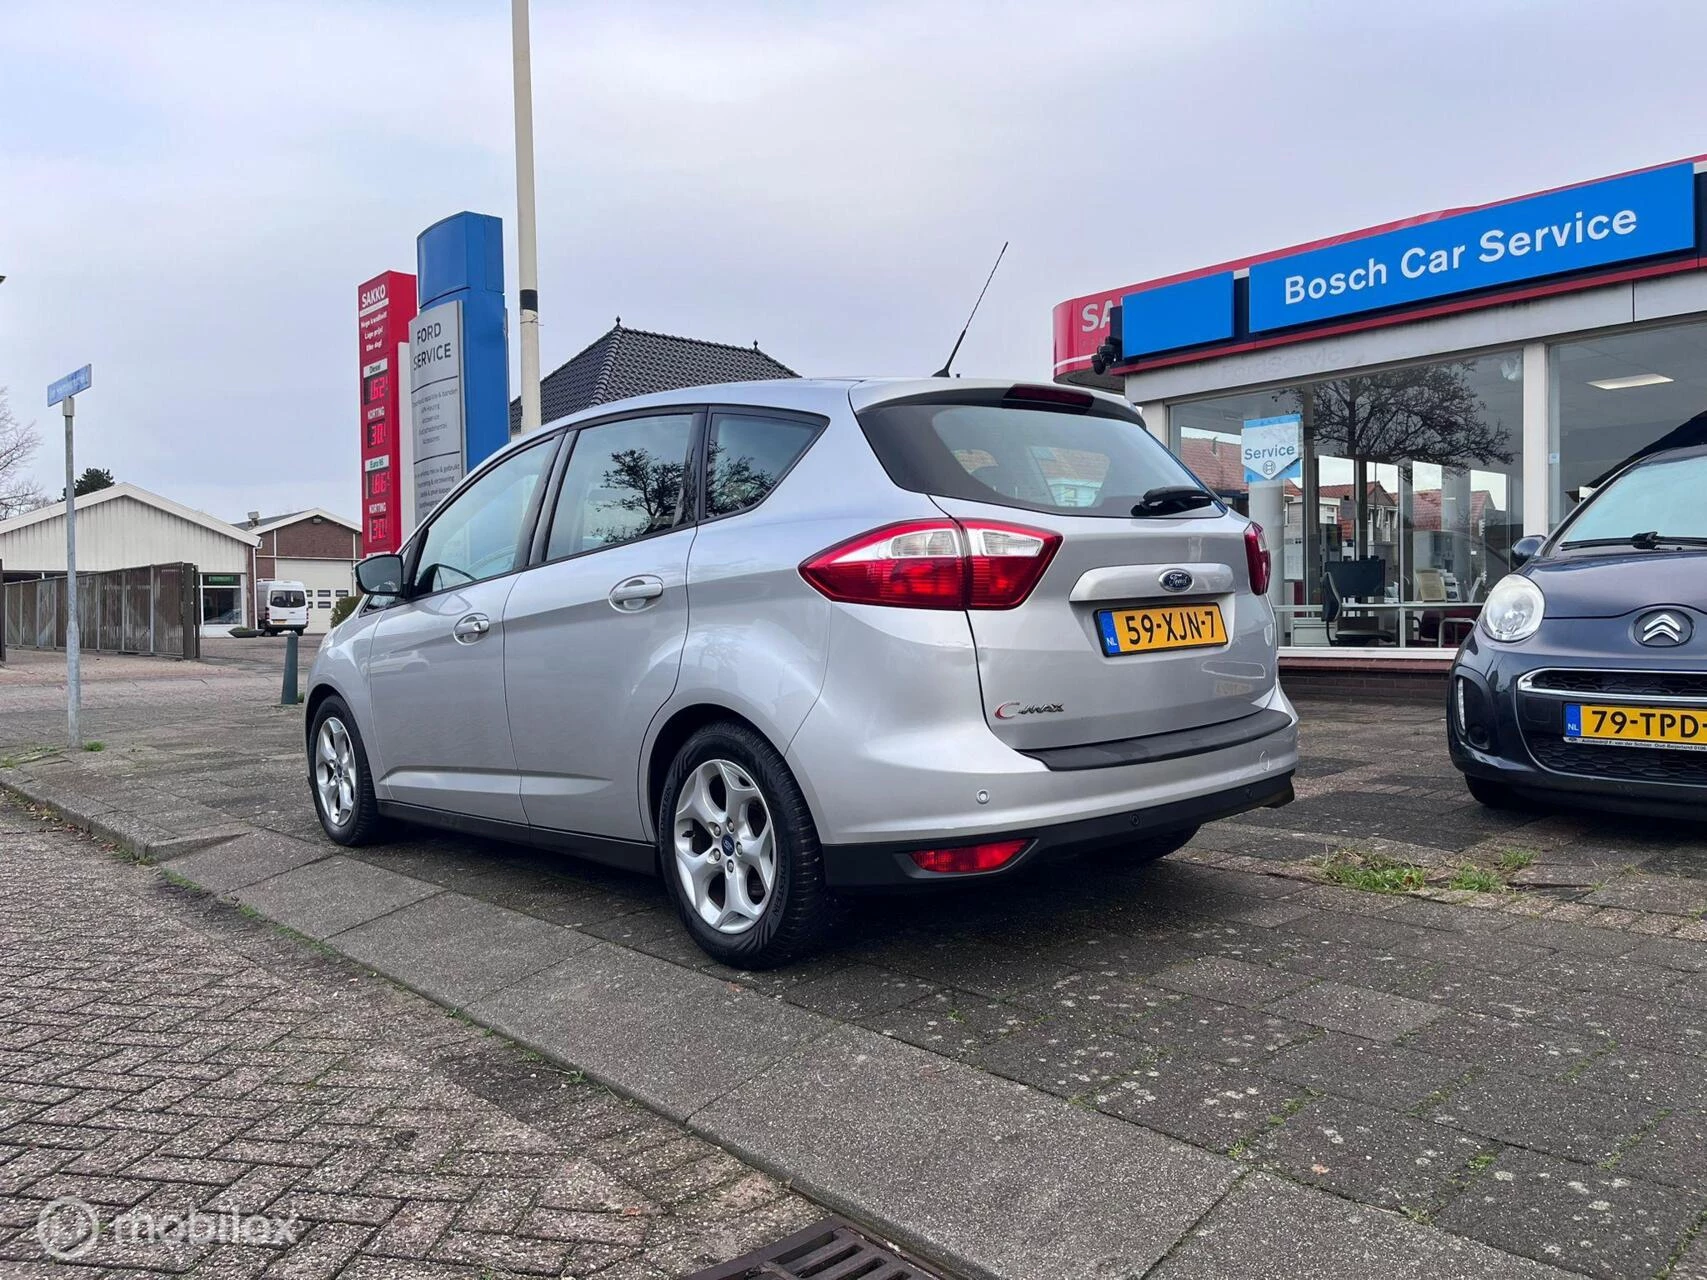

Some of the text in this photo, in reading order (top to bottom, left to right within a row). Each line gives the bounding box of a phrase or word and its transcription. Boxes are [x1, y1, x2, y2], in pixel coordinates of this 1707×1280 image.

[1285, 209, 1637, 305] Bosch Car Service
[361, 284, 386, 308] SAKKO
[1081, 300, 1111, 332] SA
[416, 322, 442, 346] FORD
[413, 342, 452, 371] SERVICE
[1244, 445, 1295, 460] Service
[1168, 573, 1188, 588] Ford
[1106, 611, 1215, 646] NL 59-XJN-7
[1567, 710, 1707, 738] NL 79-TPD-
